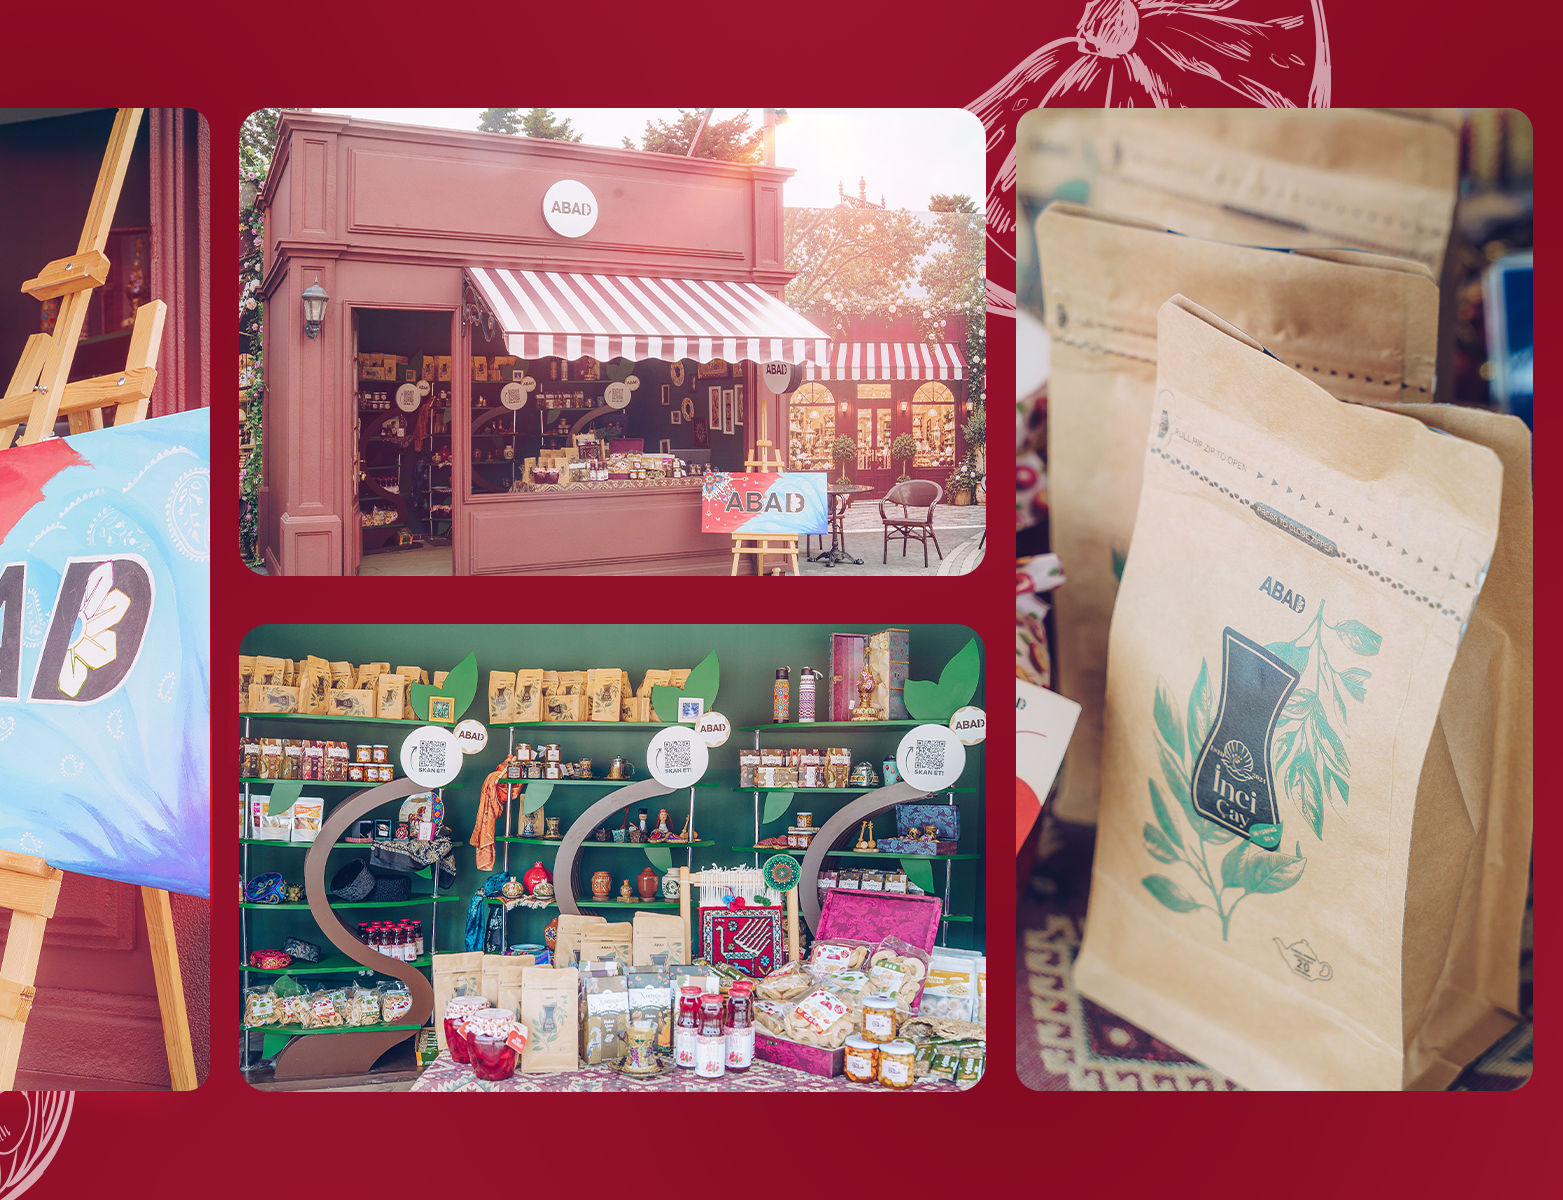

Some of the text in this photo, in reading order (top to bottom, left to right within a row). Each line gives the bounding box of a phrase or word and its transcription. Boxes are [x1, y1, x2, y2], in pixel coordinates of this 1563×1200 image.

[550, 200, 592, 217] ABAD
[766, 363, 788, 376] ABAD
[1174, 428, 1192, 444] PULL
[1203, 442, 1216, 455] ZIP
[1216, 449, 1227, 462] TO
[1227, 455, 1248, 473] OPEN
[724, 491, 806, 514] ABAD
[1256, 505, 1335, 554] PRESS TO CLOSE ZIPPER
[1258, 575, 1306, 614] ABAD
[699, 723, 726, 733] ABAD
[955, 718, 985, 730] ABAD
[458, 730, 484, 741] ABAD
[1216, 798, 1251, 829] Çay
